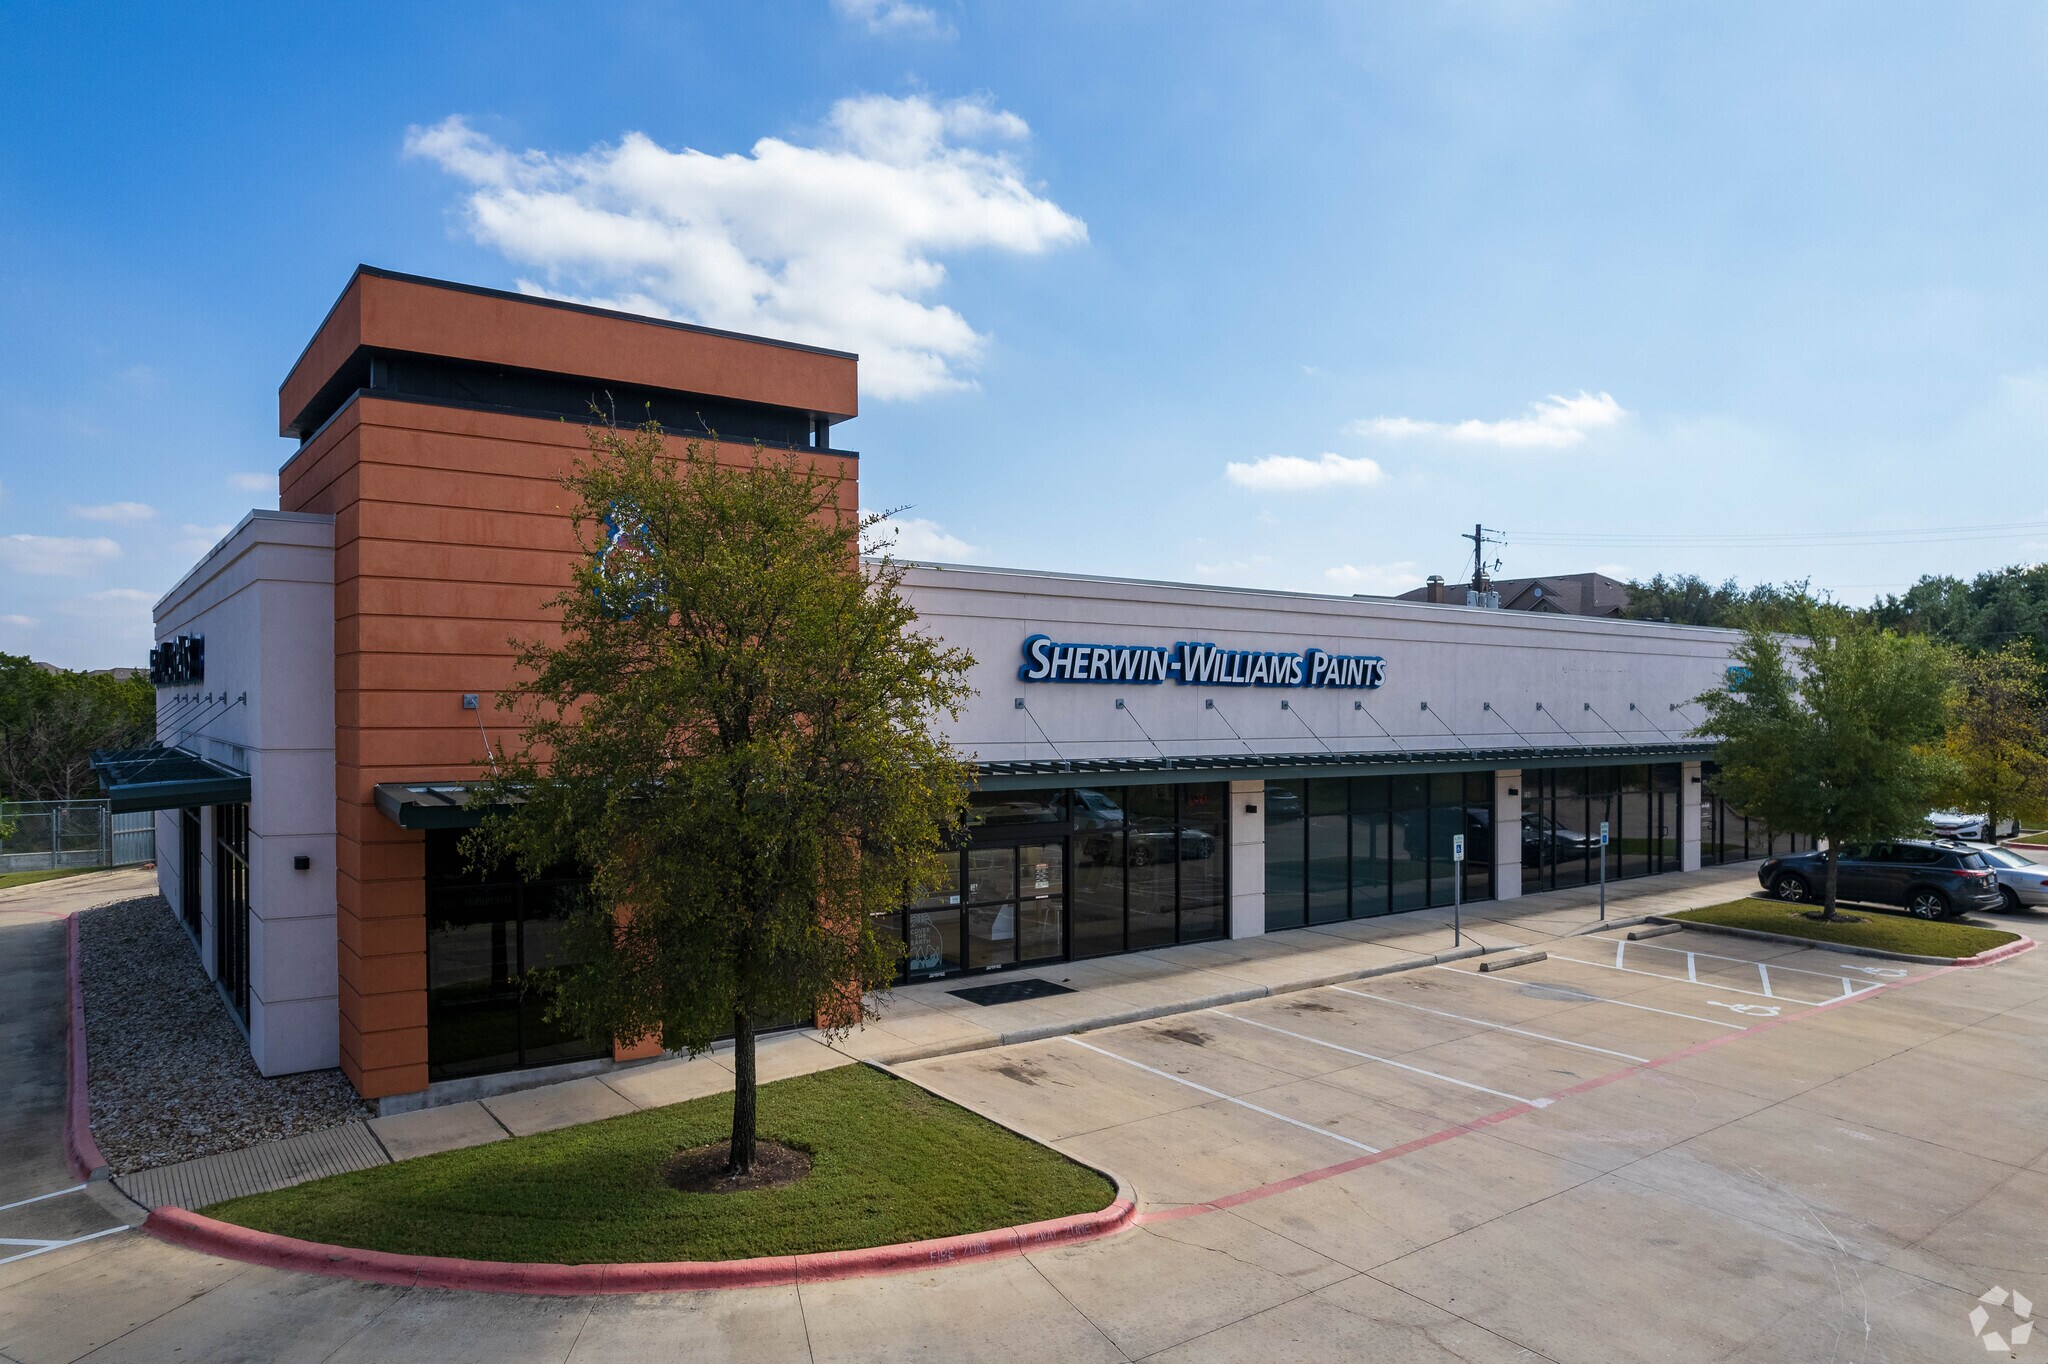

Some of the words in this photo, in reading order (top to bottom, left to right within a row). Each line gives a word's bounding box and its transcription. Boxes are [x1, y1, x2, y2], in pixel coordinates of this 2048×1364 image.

[1028, 639, 1303, 684] SHERWIN-WILLIAMS
[1311, 651, 1387, 686] PAINTS
[910, 927, 931, 935] COVER
[911, 938, 931, 946] EARTH
